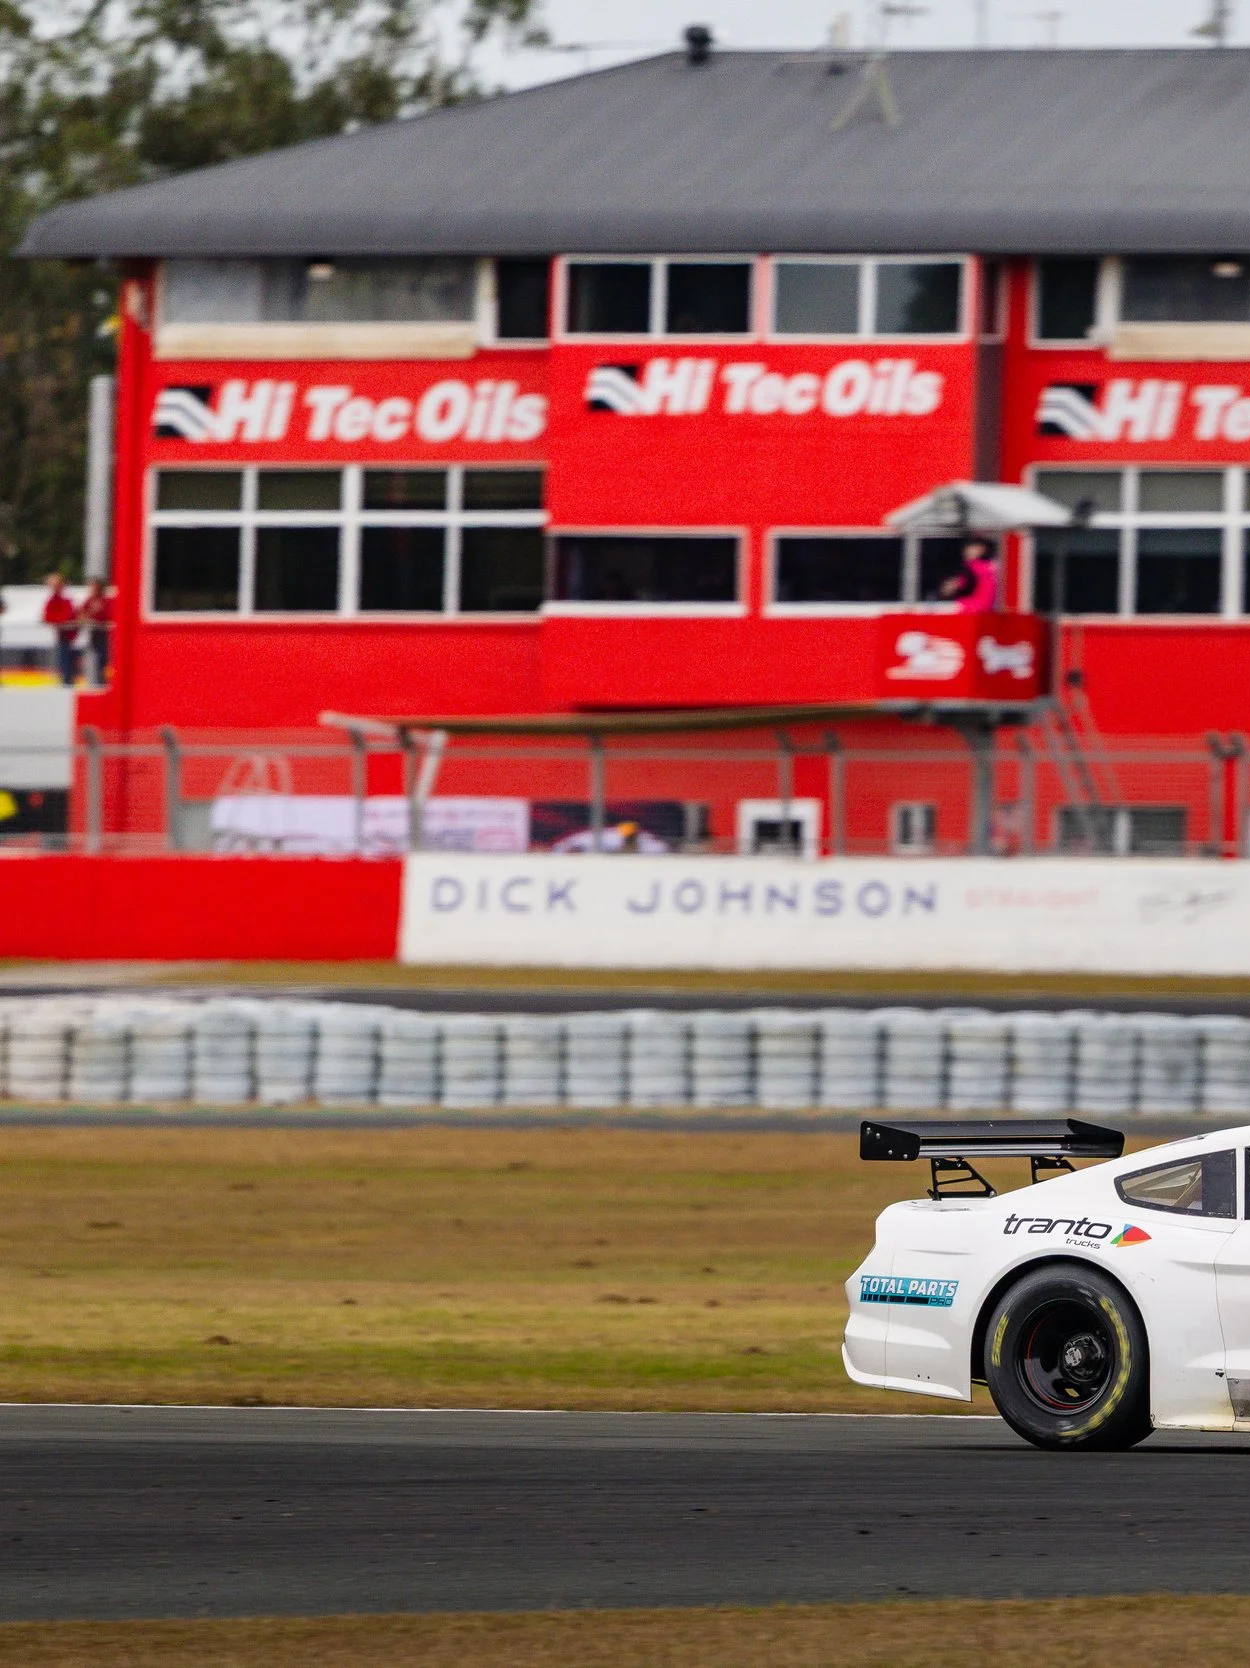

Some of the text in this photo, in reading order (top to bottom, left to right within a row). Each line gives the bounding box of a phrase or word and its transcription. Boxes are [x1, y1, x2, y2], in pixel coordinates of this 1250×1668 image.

[640, 358, 944, 417] Hi Tec Oils
[214, 379, 549, 443] Hi Tec Oils
[1101, 380, 1184, 442] Hi
[431, 875, 578, 914] DICK
[626, 879, 938, 918] JOHNSON
[1003, 1213, 1113, 1239] tranto
[1066, 1237, 1101, 1250] trucks
[861, 1277, 957, 1297] TOTAL PARTS
